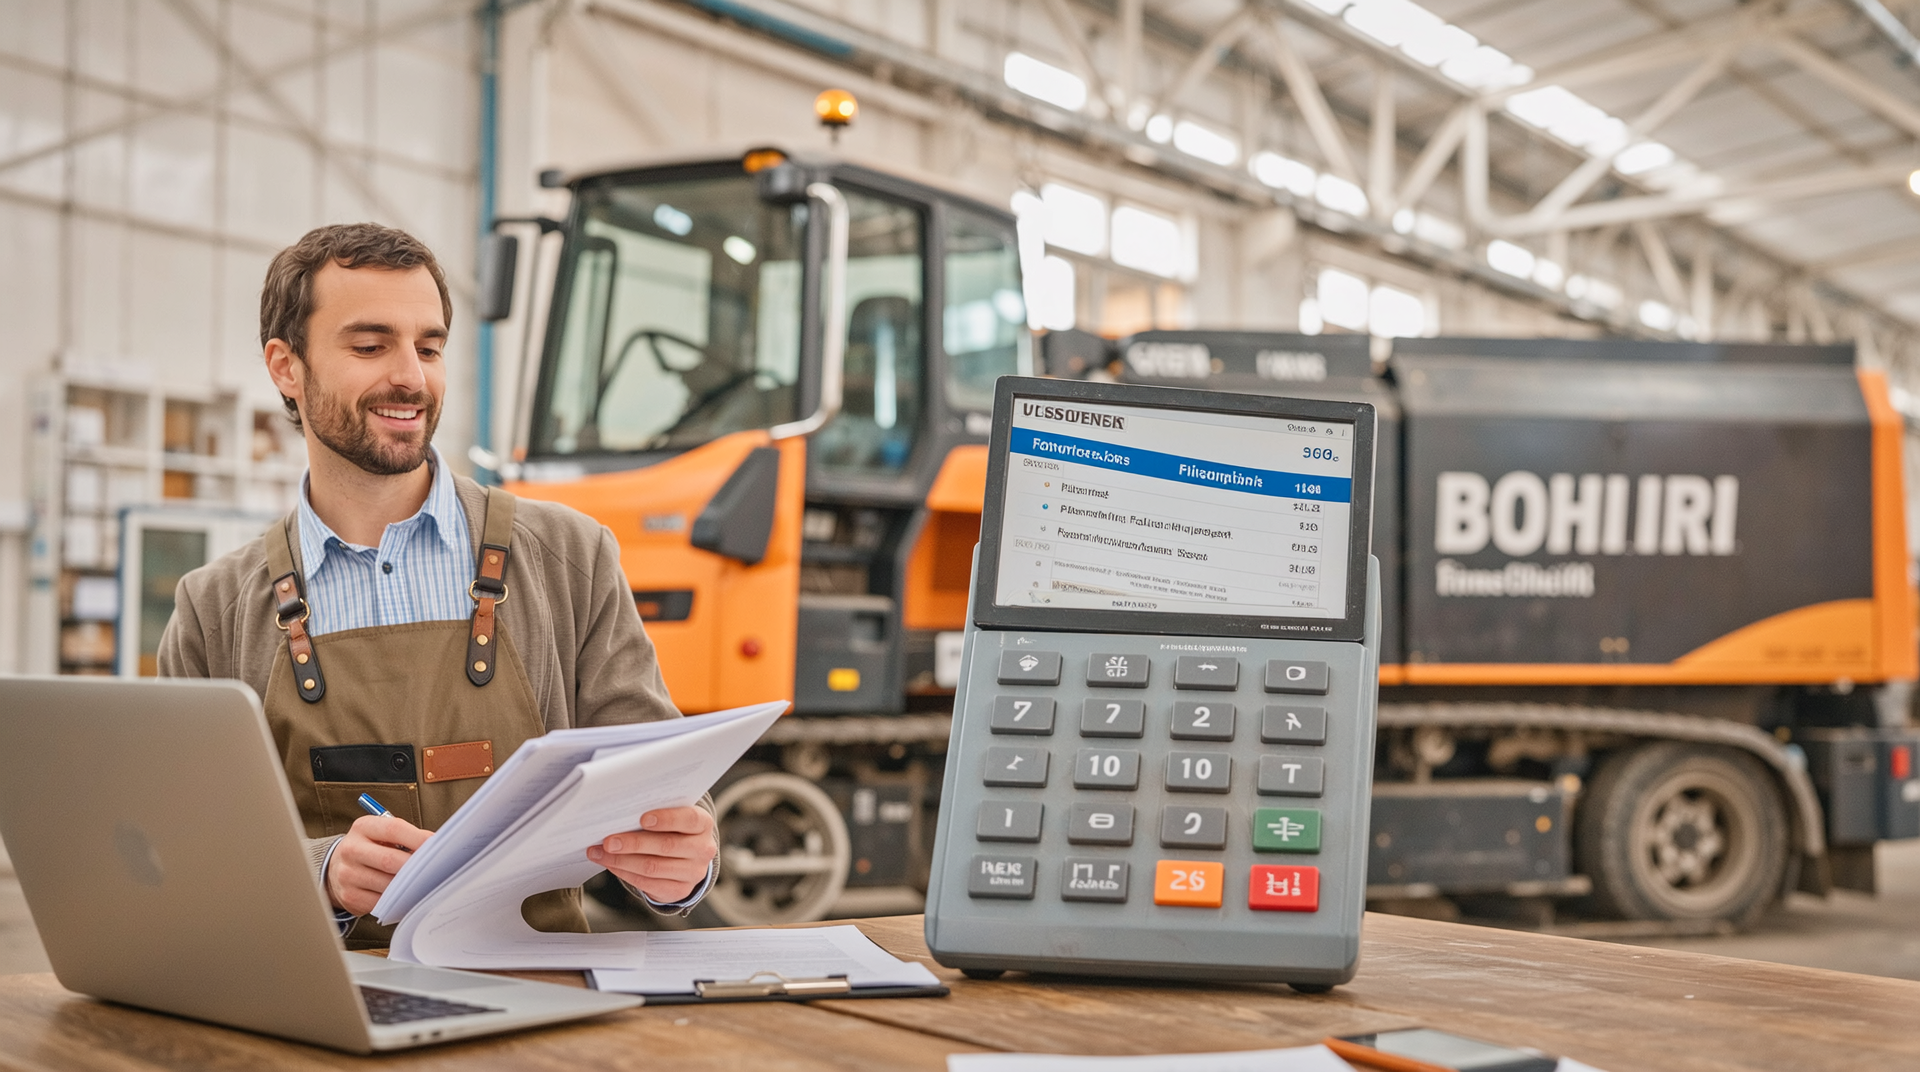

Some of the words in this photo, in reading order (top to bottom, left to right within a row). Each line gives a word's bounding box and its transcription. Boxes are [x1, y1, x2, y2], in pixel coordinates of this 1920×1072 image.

[1013, 701, 1032, 722] 7
[1105, 703, 1121, 724] 7
[1192, 706, 1211, 728] 2
[1089, 754, 1121, 777] 10
[1181, 757, 1212, 780] 10
[1282, 763, 1302, 784] T
